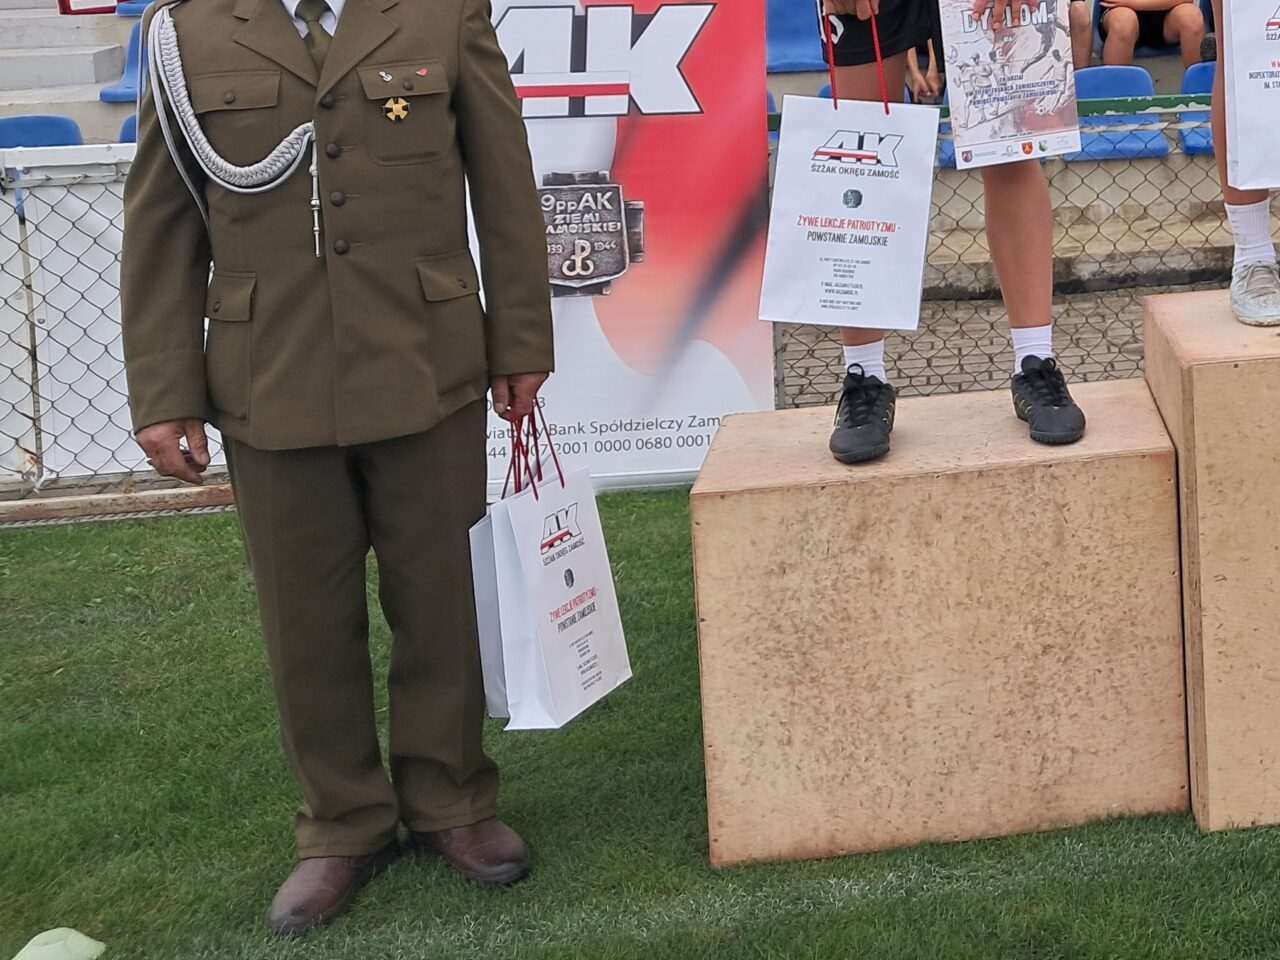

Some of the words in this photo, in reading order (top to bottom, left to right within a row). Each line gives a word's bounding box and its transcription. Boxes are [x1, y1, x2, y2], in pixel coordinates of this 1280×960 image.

[494, 3, 718, 118] AK
[811, 129, 904, 168] AK
[553, 213, 599, 224] ZIEMI
[549, 422, 586, 437] Bank
[590, 418, 683, 435] Spółdzielczy
[688, 415, 721, 428] Zam
[594, 440, 631, 453] 0000
[635, 437, 672, 451] 0680
[676, 434, 712, 448] 0001
